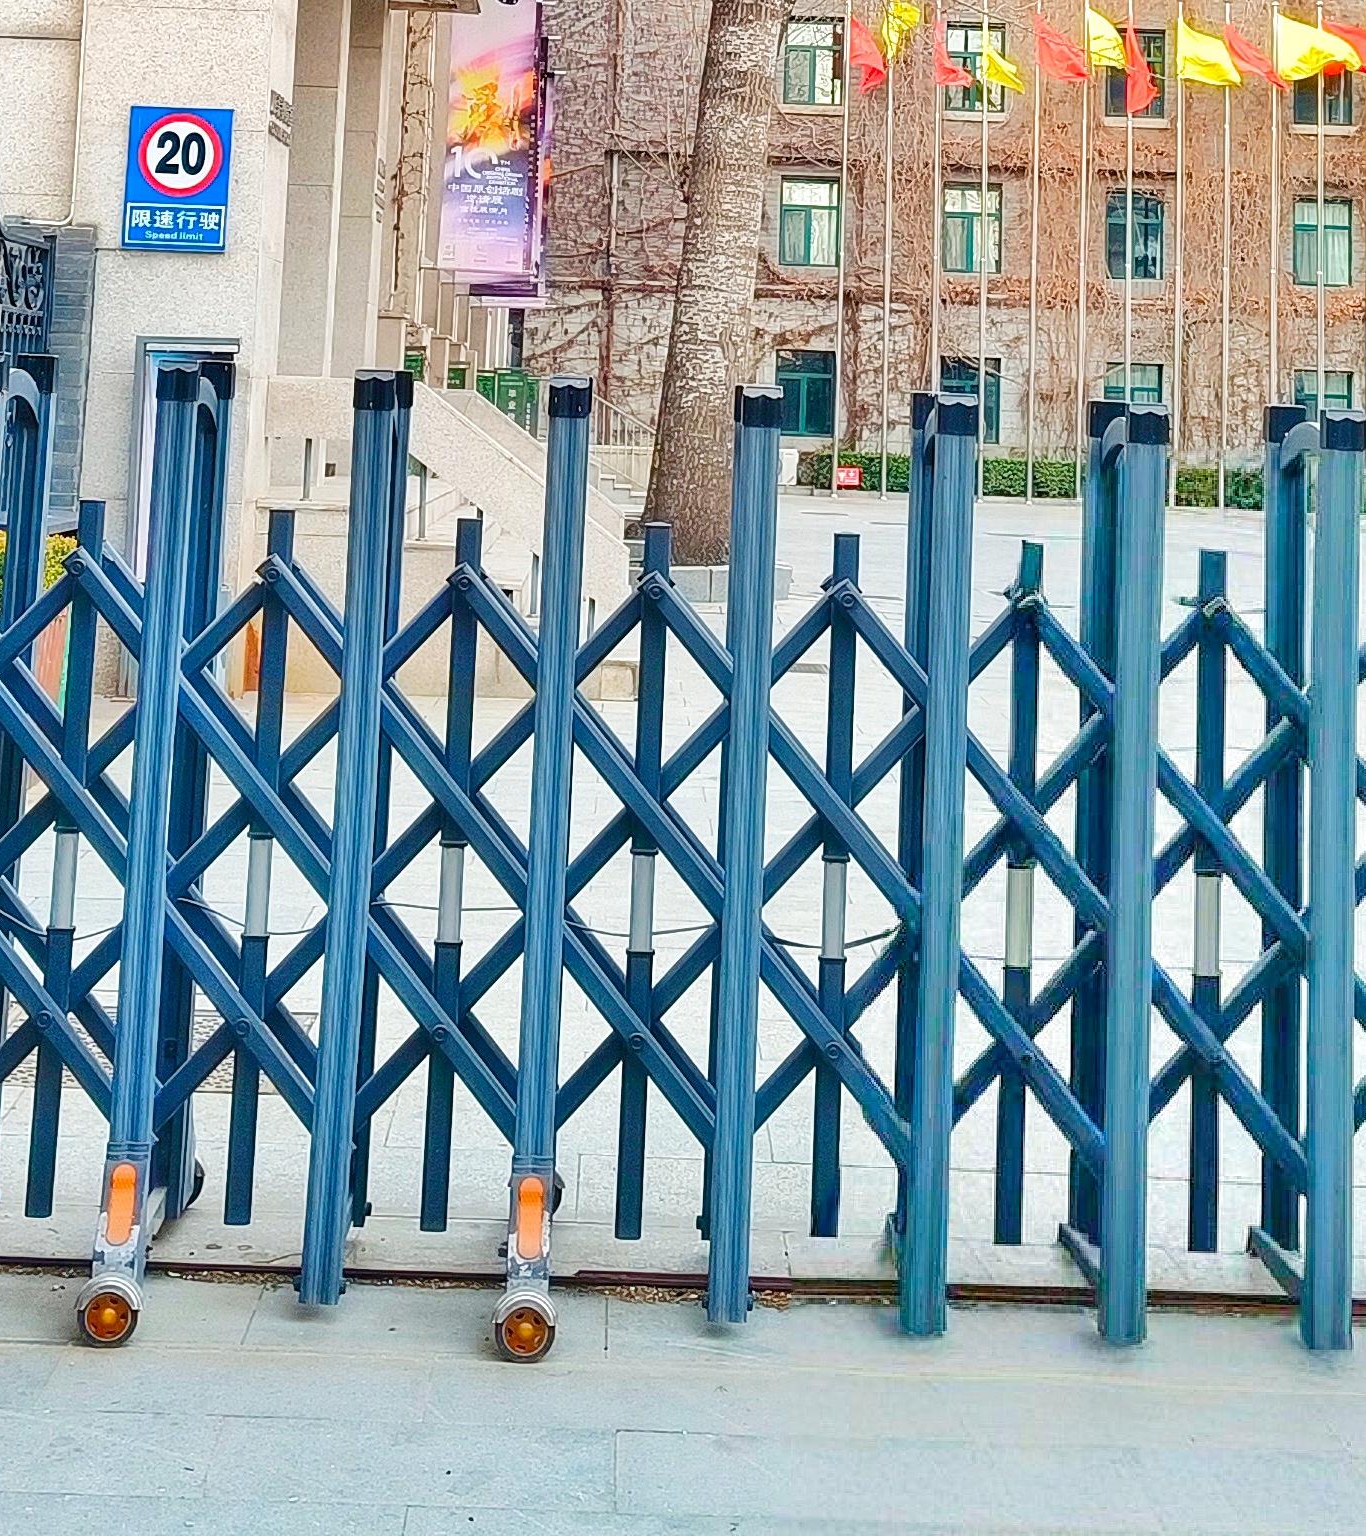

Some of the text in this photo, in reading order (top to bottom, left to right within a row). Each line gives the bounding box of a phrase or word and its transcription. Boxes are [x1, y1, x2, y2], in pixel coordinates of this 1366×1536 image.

[154, 130, 206, 176] 20
[130, 208, 221, 230] 限速行驶
[144, 230, 204, 241] Speed limit
